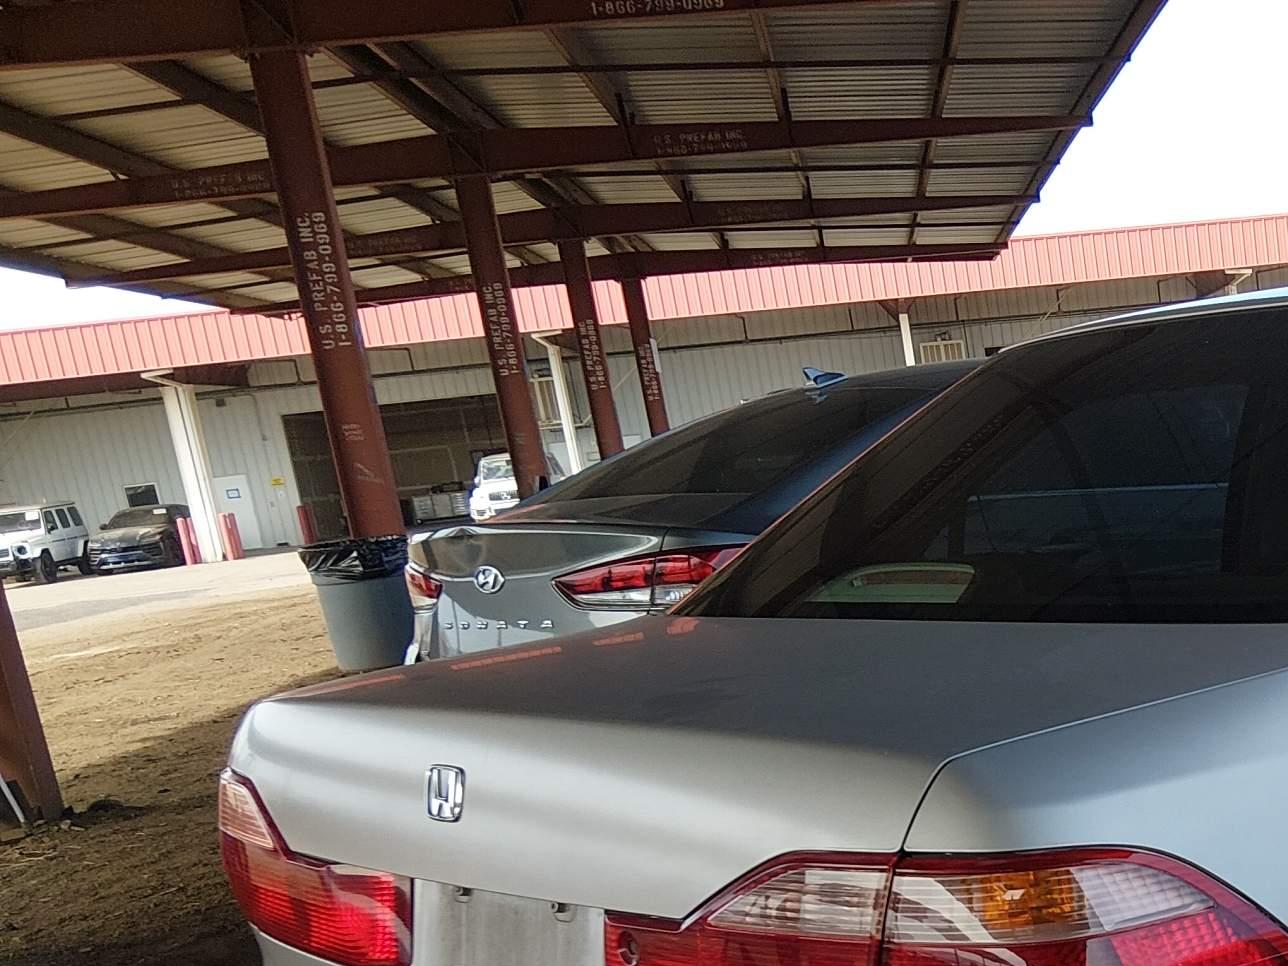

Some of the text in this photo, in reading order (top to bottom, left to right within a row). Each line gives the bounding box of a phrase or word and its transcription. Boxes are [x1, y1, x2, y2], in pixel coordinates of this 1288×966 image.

[297, 211, 336, 350] U.S. PREFAB INC.
[311, 211, 352, 346] 1-866-799-0969
[487, 308, 505, 350] PREFAB
[493, 282, 520, 374] 1-866-799-0969
